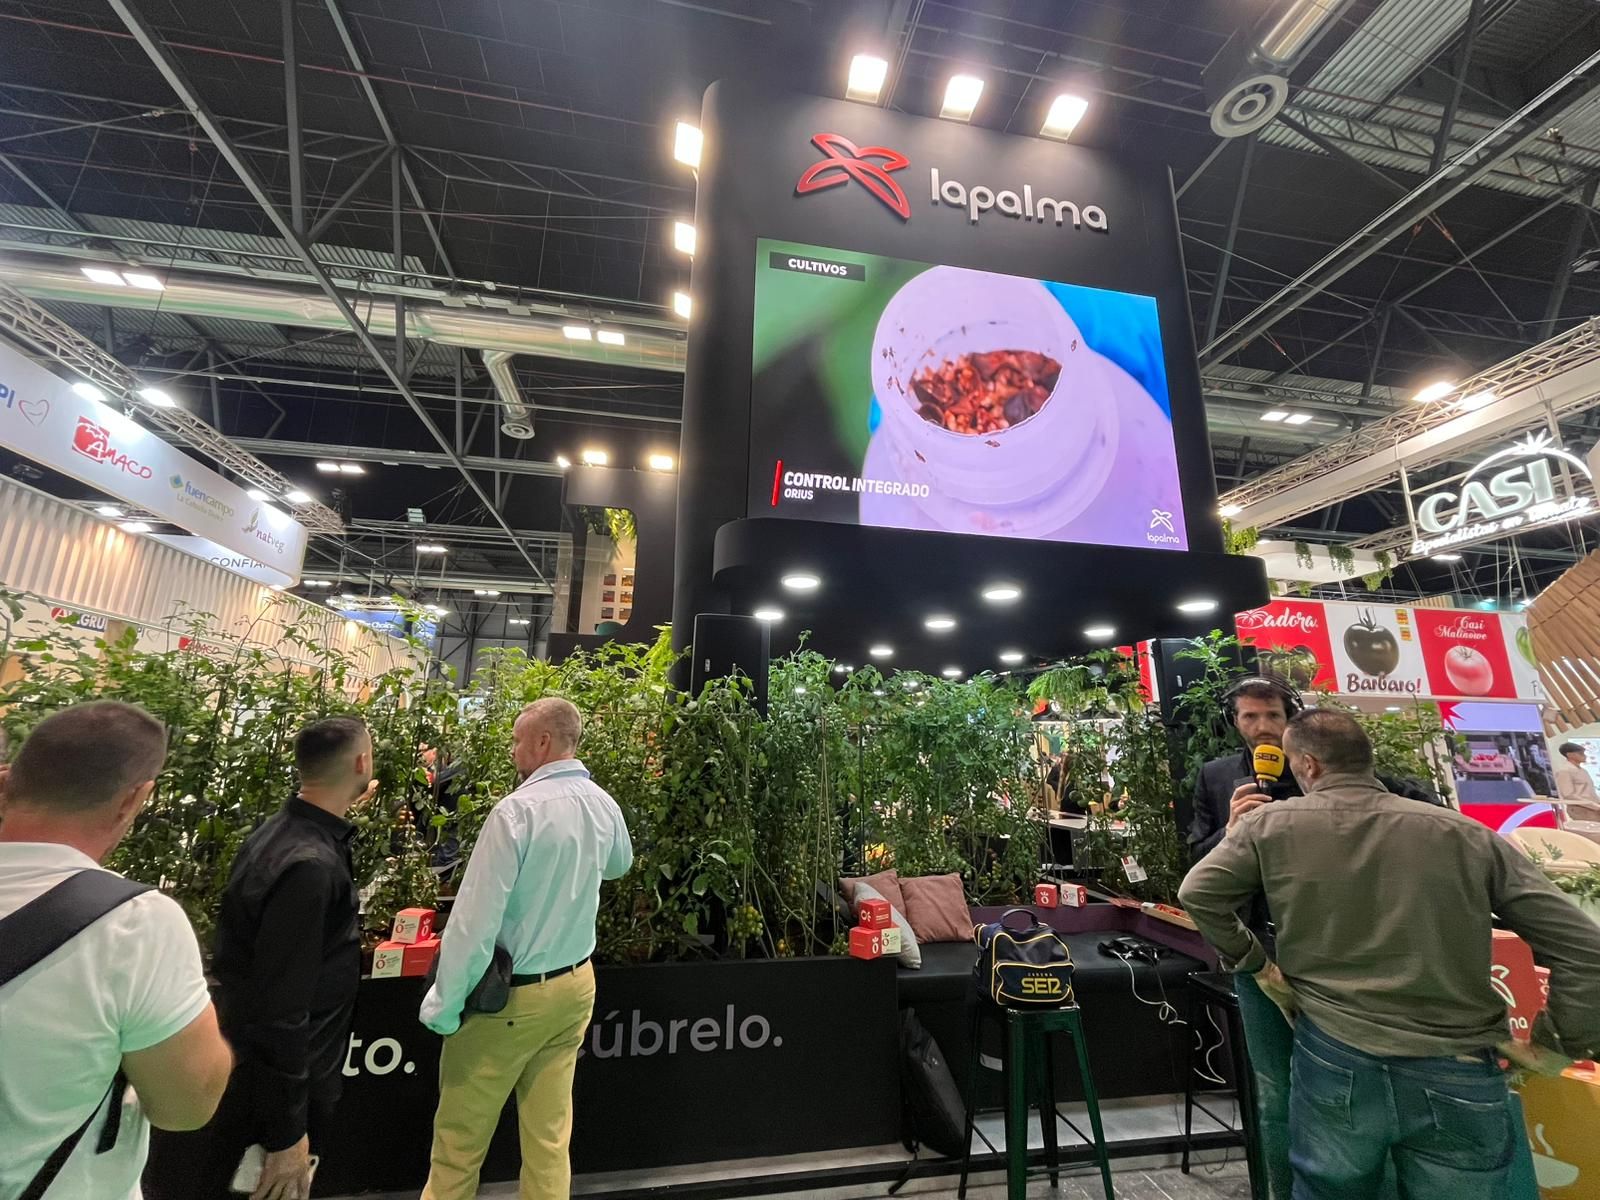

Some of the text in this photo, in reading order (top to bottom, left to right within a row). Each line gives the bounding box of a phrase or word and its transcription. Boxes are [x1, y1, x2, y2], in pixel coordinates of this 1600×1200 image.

[930, 168, 1109, 232] lapalma
[788, 258, 848, 277] CULTIVOS
[784, 471, 930, 498] CONTROL INTEGRADO
[784, 487, 814, 500] ORIUS
[1418, 458, 1554, 533] CASI
[184, 480, 234, 517] fuencampo
[256, 528, 285, 554] natveg
[1146, 532, 1180, 544] lapalma
[1347, 673, 1422, 693] Barbaro!
[1021, 977, 1062, 994] SER
[577, 1004, 784, 1060] úbrelo.
